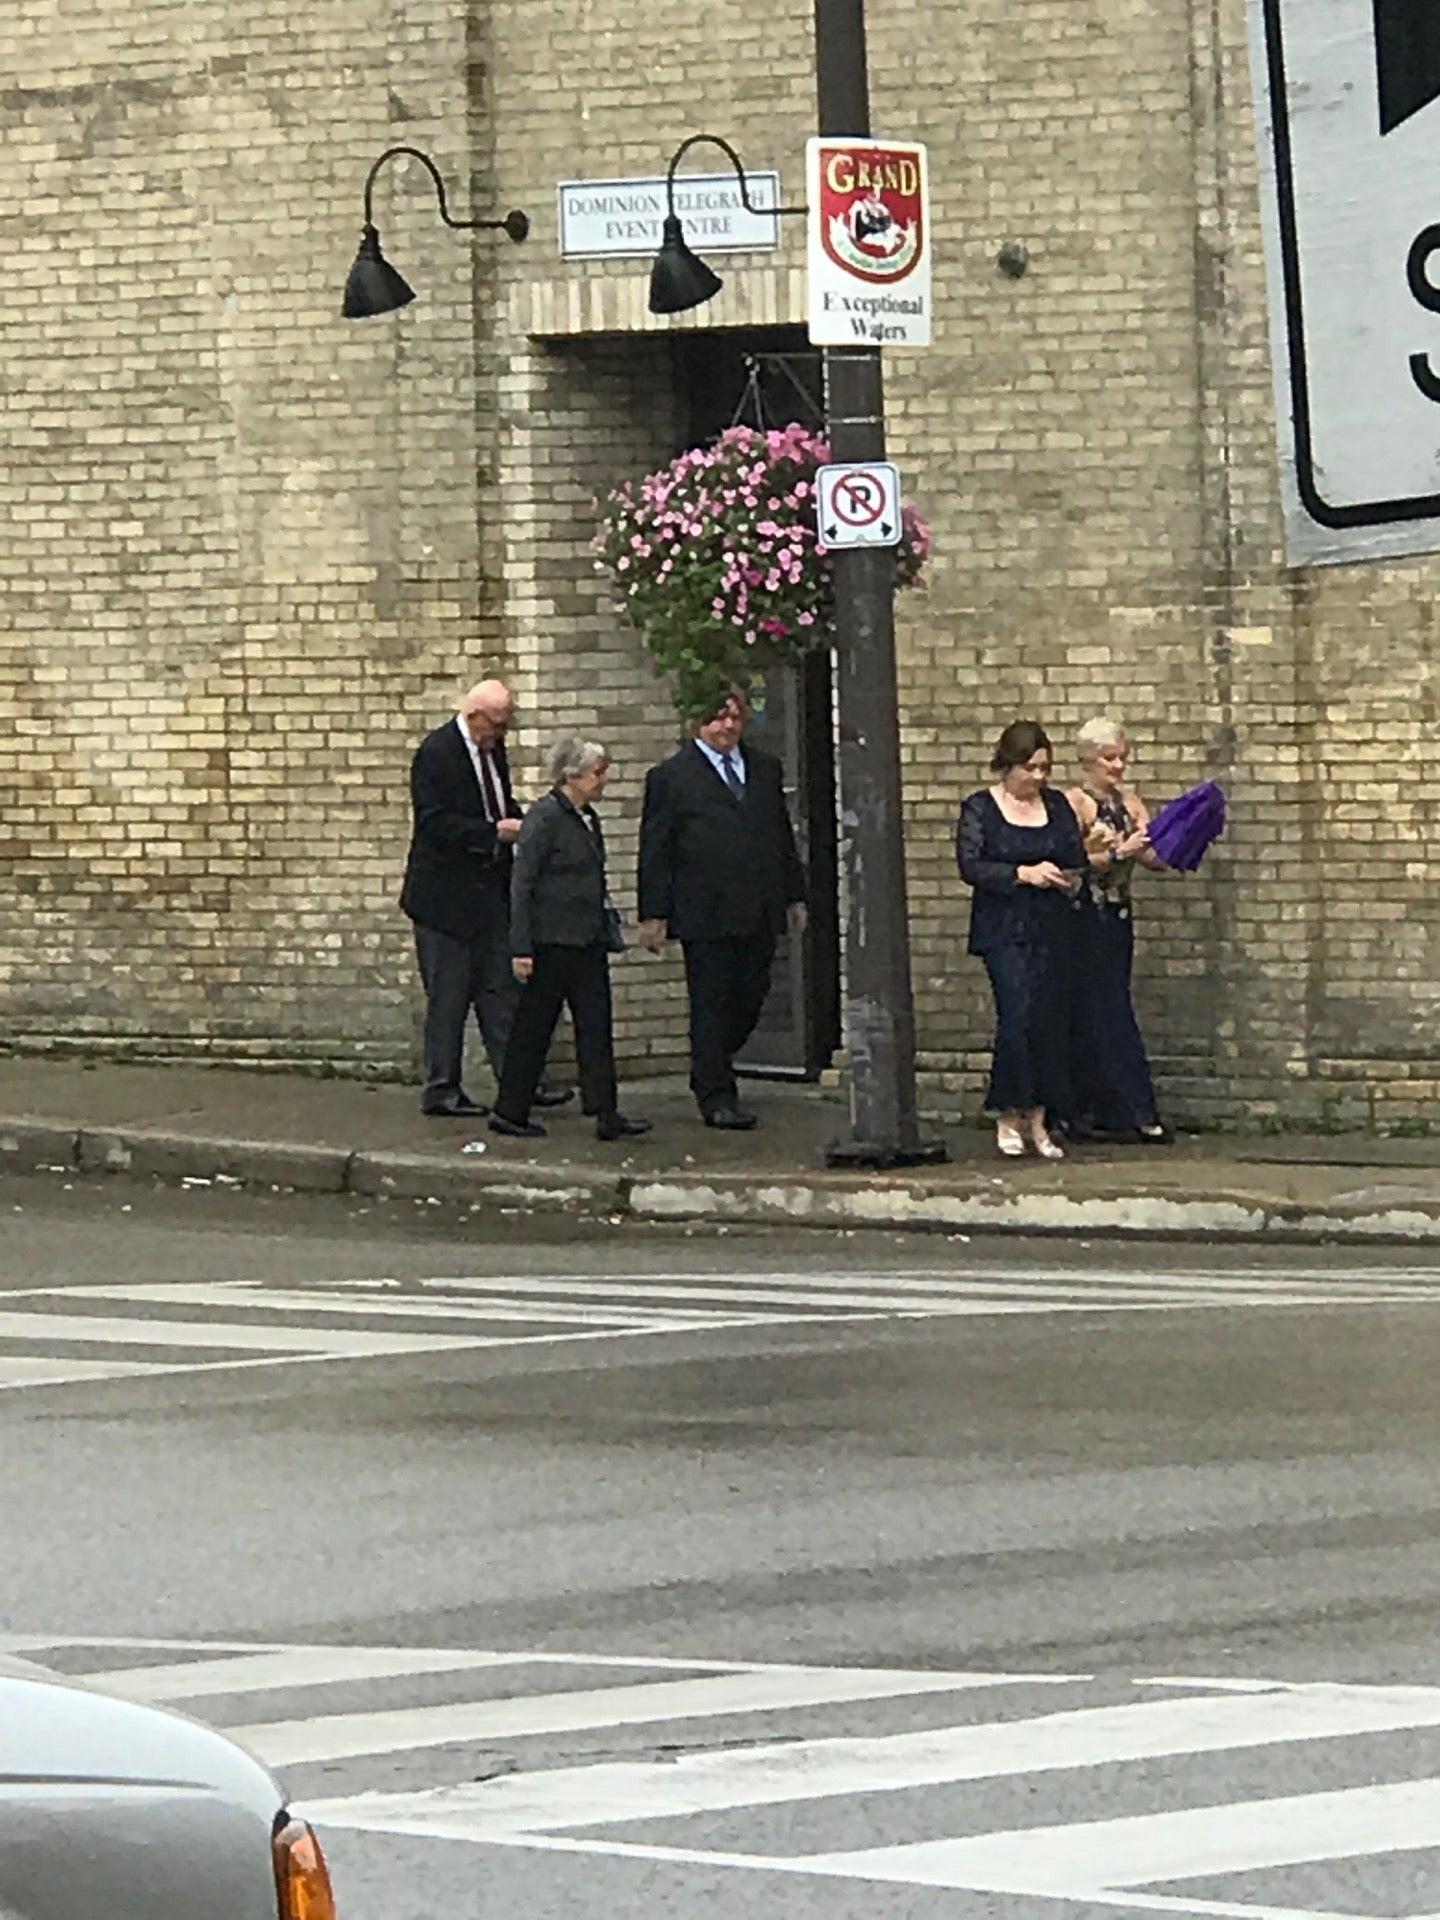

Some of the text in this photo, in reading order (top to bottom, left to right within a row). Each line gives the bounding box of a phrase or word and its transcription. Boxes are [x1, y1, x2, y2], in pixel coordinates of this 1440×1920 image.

[826, 152, 918, 197] GRAND
[568, 189, 764, 216] DOMINION ELEGRAH
[606, 216, 732, 239] EVENT NTRE
[823, 292, 924, 317] Exceptional
[851, 317, 907, 341] Waters
